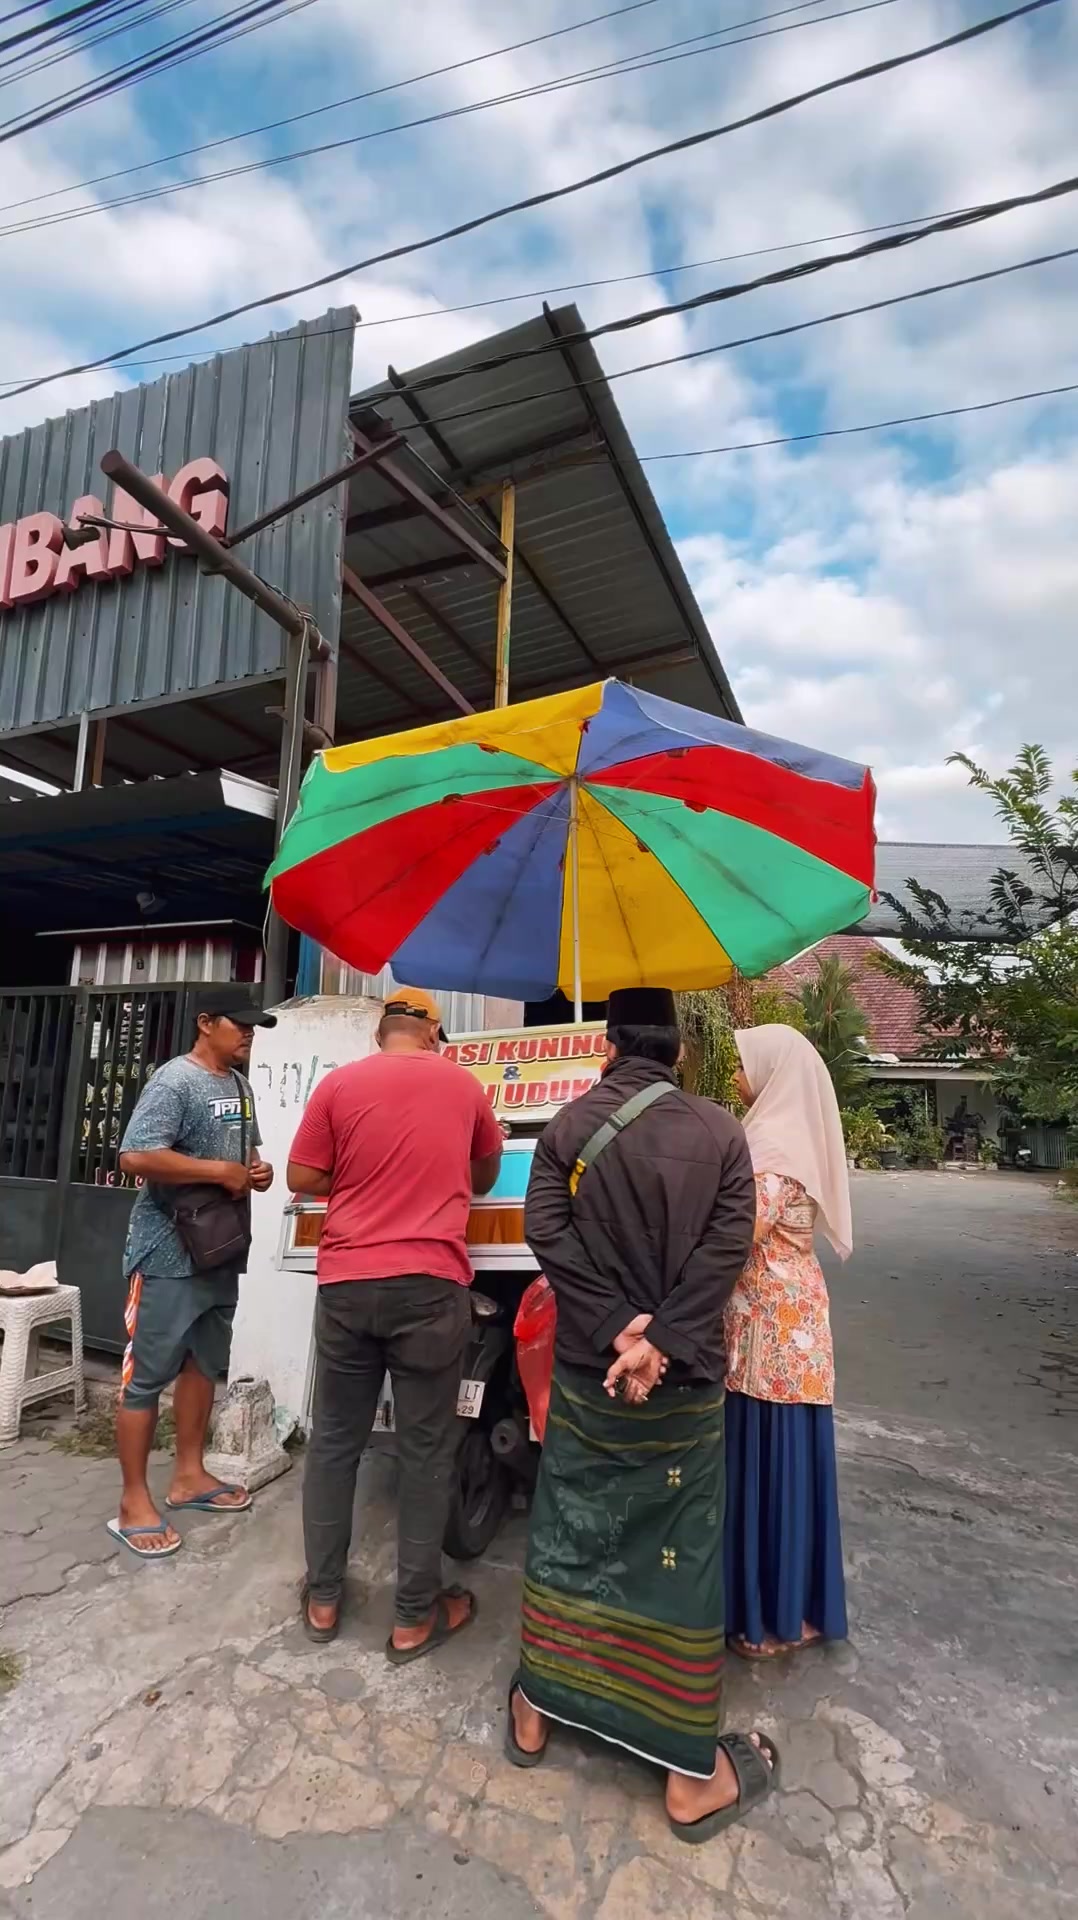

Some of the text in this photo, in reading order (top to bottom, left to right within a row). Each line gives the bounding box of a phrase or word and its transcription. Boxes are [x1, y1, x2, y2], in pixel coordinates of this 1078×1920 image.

[440, 1042, 494, 1066] ASI
[503, 1066, 521, 1080] &
[465, 1384, 480, 1399] LT
